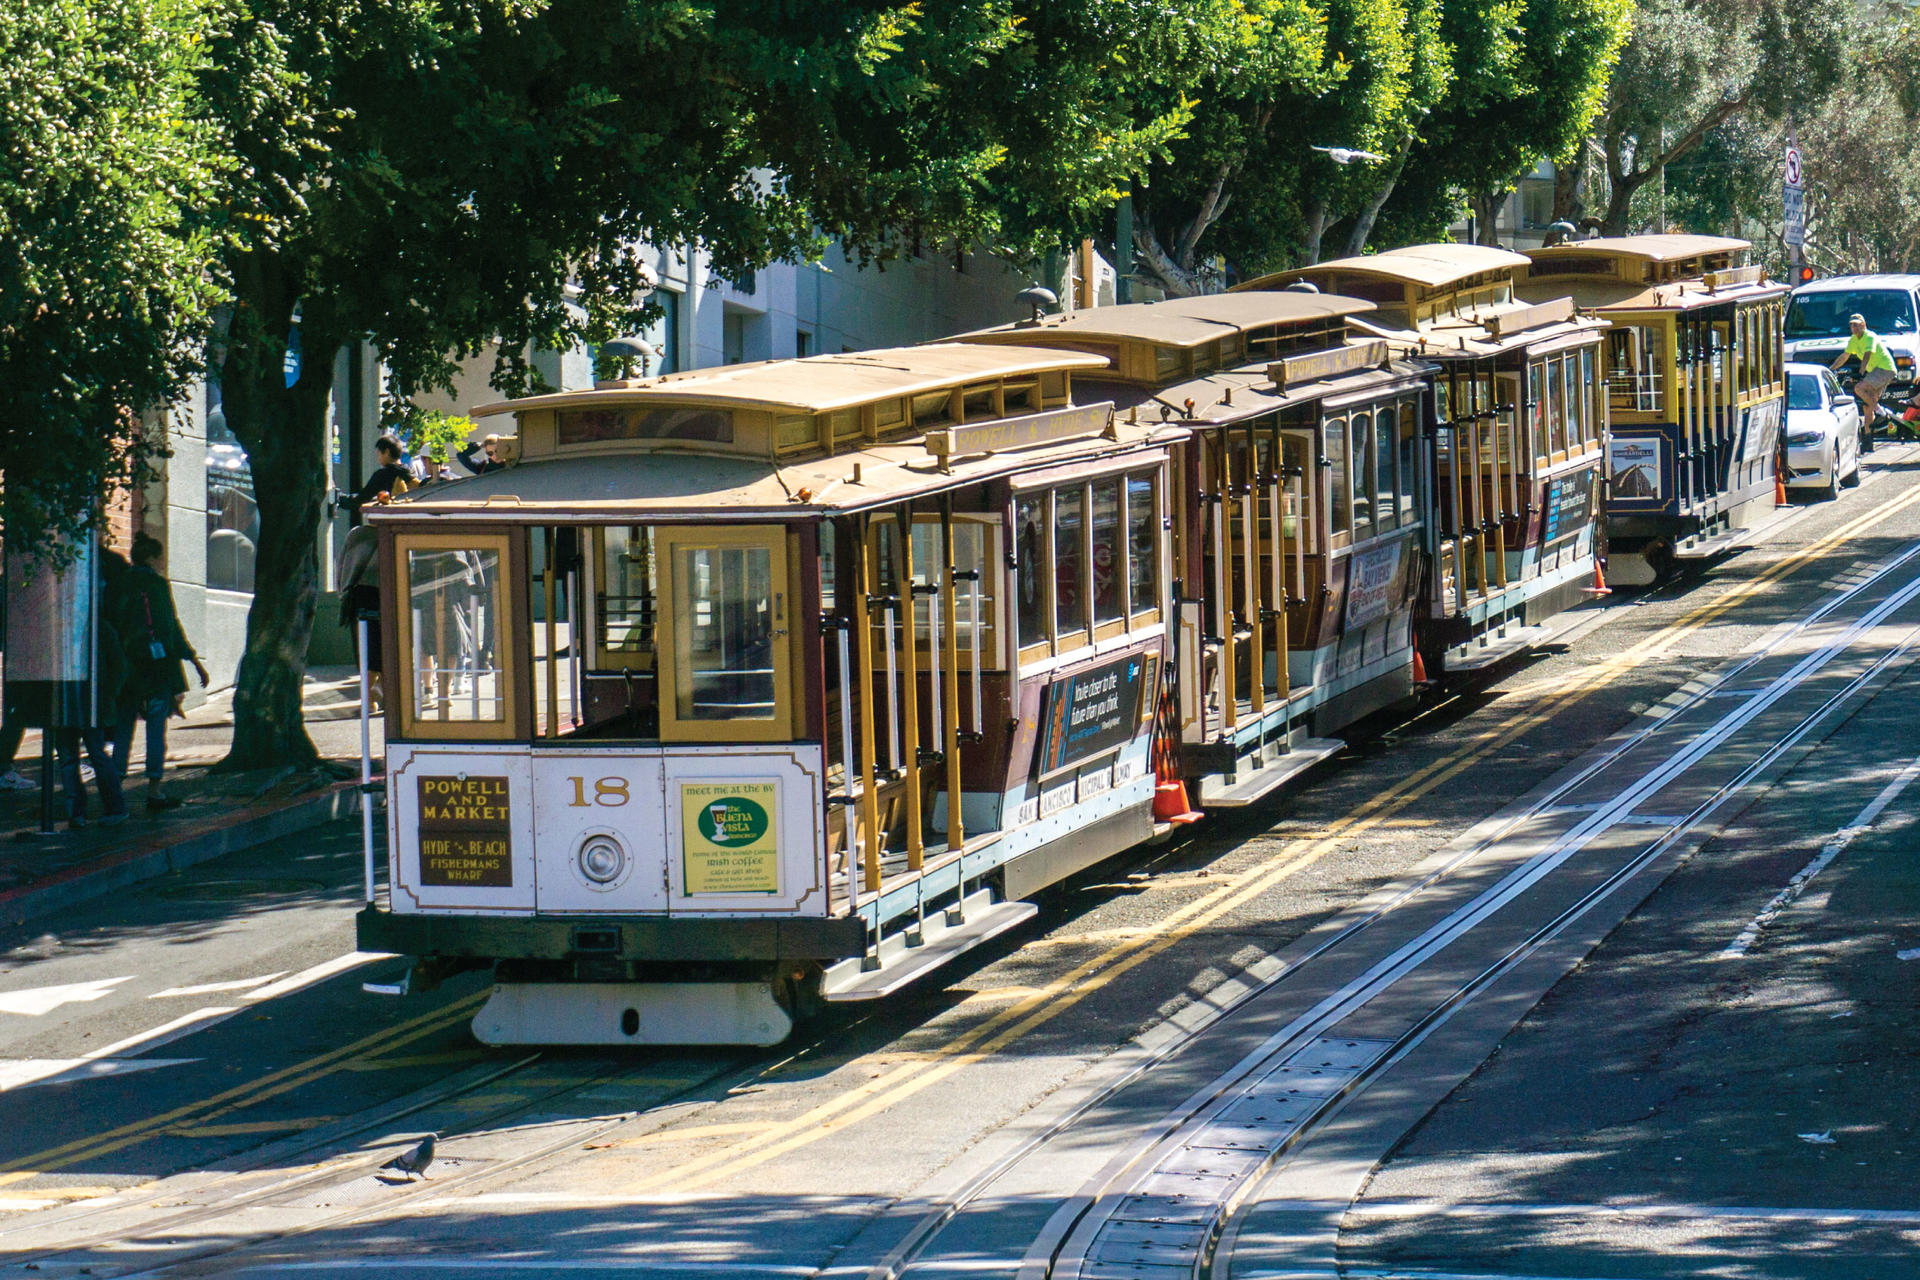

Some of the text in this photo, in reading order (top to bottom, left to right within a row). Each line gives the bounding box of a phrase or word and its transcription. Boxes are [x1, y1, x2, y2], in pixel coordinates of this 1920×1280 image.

[1290, 356, 1330, 378] POWELL
[958, 424, 1018, 450] POWELL
[1029, 420, 1039, 440] &
[1050, 412, 1086, 436] HYDE
[1088, 678, 1103, 698] closer
[1102, 676, 1109, 693] to
[1108, 672, 1118, 690] the
[1071, 691, 1119, 726] future than you think
[424, 780, 506, 794] POWELL
[566, 776, 630, 807] 18
[686, 787, 711, 796] meet
[714, 786, 728, 794] me
[730, 786, 740, 794] at
[744, 784, 760, 793] the
[447, 796, 488, 806] AND
[424, 806, 508, 820] MARKET
[716, 812, 752, 822] BUENA
[1018, 802, 1033, 824] SAN
[722, 824, 750, 832] VISTA
[424, 840, 452, 855] HYDE
[469, 840, 506, 856] BEACH
[430, 858, 500, 869] FISHERMANS
[448, 870, 482, 880] WHARF
